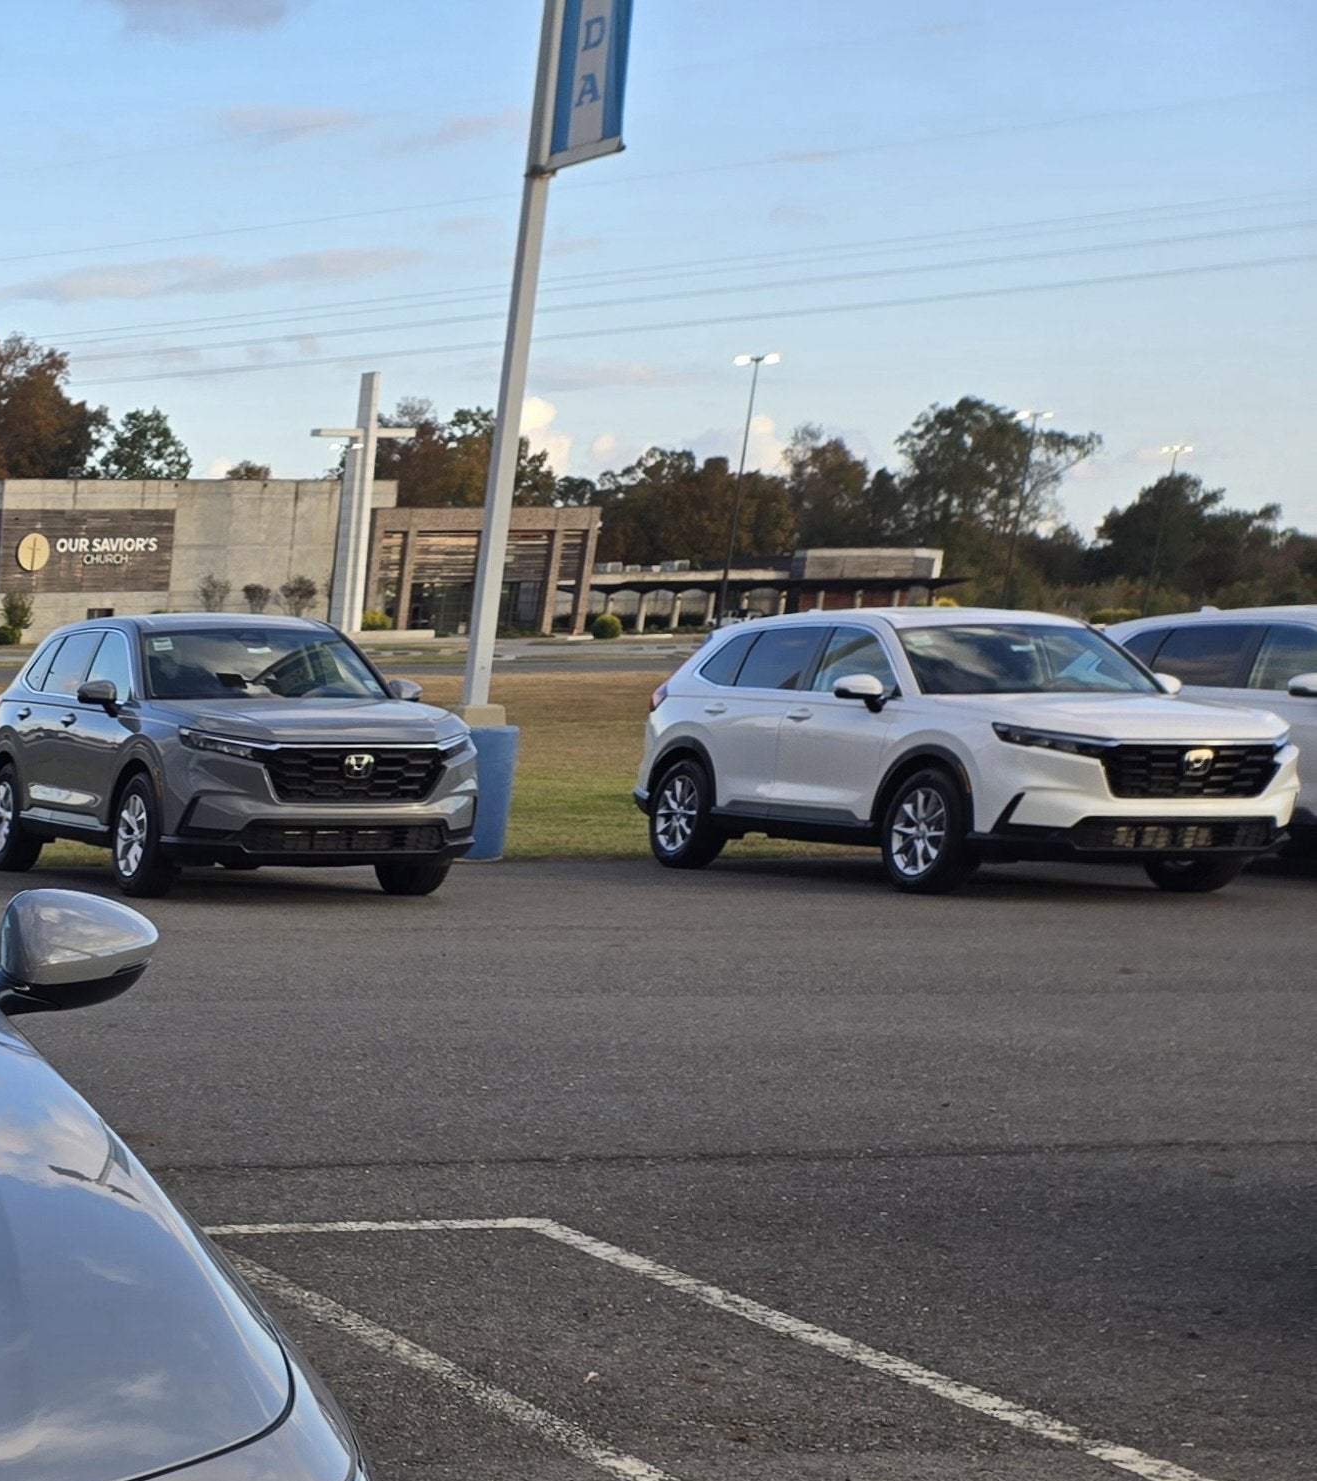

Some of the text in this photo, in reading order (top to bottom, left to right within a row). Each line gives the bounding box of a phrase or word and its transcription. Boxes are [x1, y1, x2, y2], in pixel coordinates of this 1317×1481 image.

[55, 537, 158, 553] OUR SAVIOR'S
[82, 553, 129, 565] CHURCH
